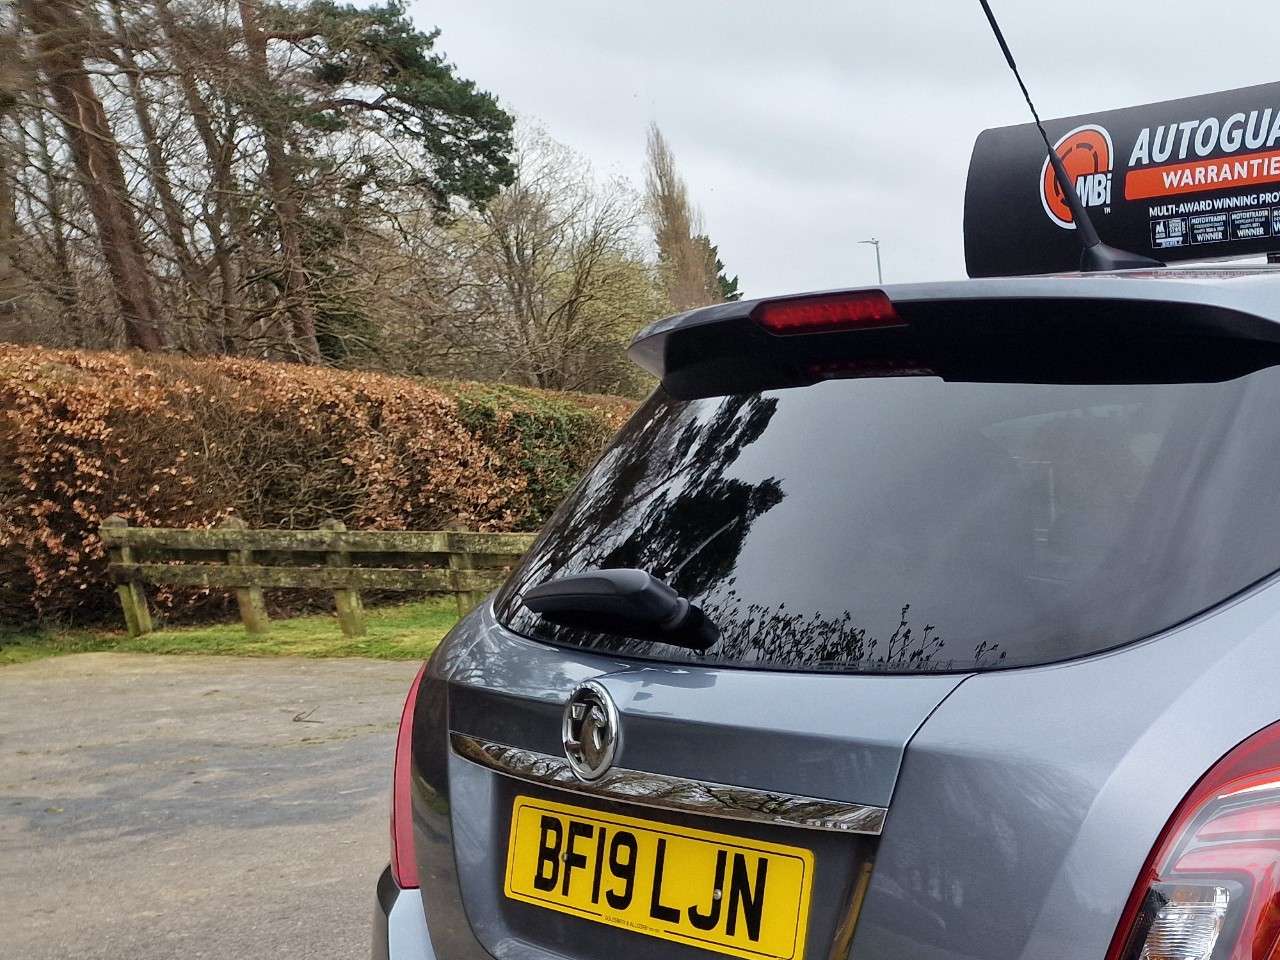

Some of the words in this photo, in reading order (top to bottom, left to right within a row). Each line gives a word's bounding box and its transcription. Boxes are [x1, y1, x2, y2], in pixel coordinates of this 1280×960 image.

[1149, 199, 1213, 217] MULTI-AWARD
[1213, 194, 1258, 210] WINNING
[1196, 231, 1223, 242] WINNER
[1236, 226, 1265, 238] WINNER
[533, 814, 638, 911] BF19
[650, 837, 769, 942] LJN
